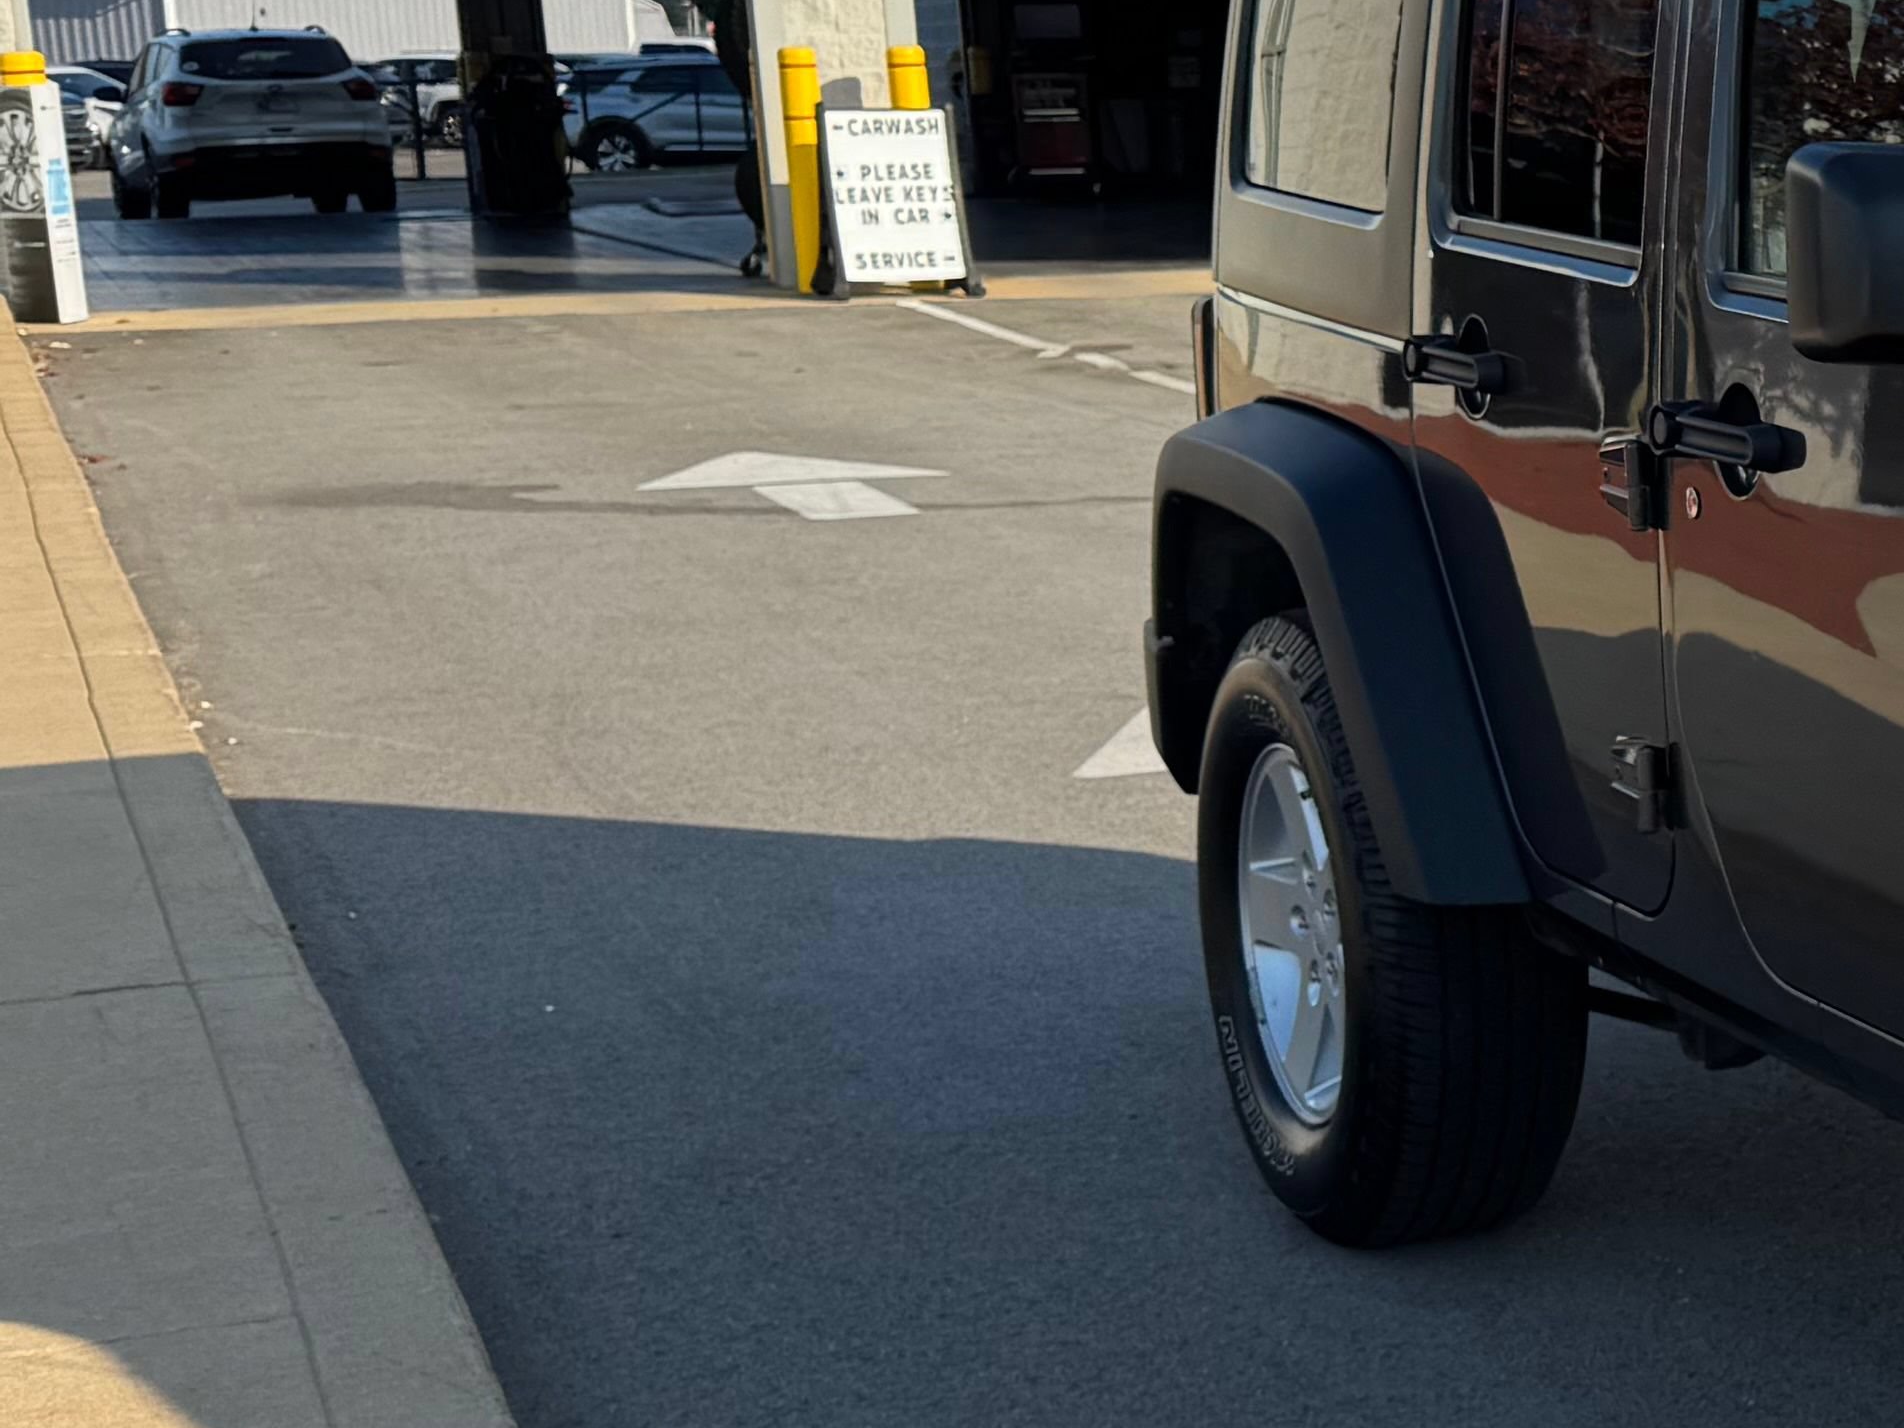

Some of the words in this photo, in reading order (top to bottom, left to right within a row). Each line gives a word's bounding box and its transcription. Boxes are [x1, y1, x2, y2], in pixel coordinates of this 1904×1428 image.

[847, 118, 939, 137] CARWASH
[860, 163, 934, 181] PLEASE
[835, 185, 895, 204] LEAVE
[861, 208, 880, 225] IN
[894, 207, 931, 225] CAR
[855, 251, 938, 270] SERVICE
